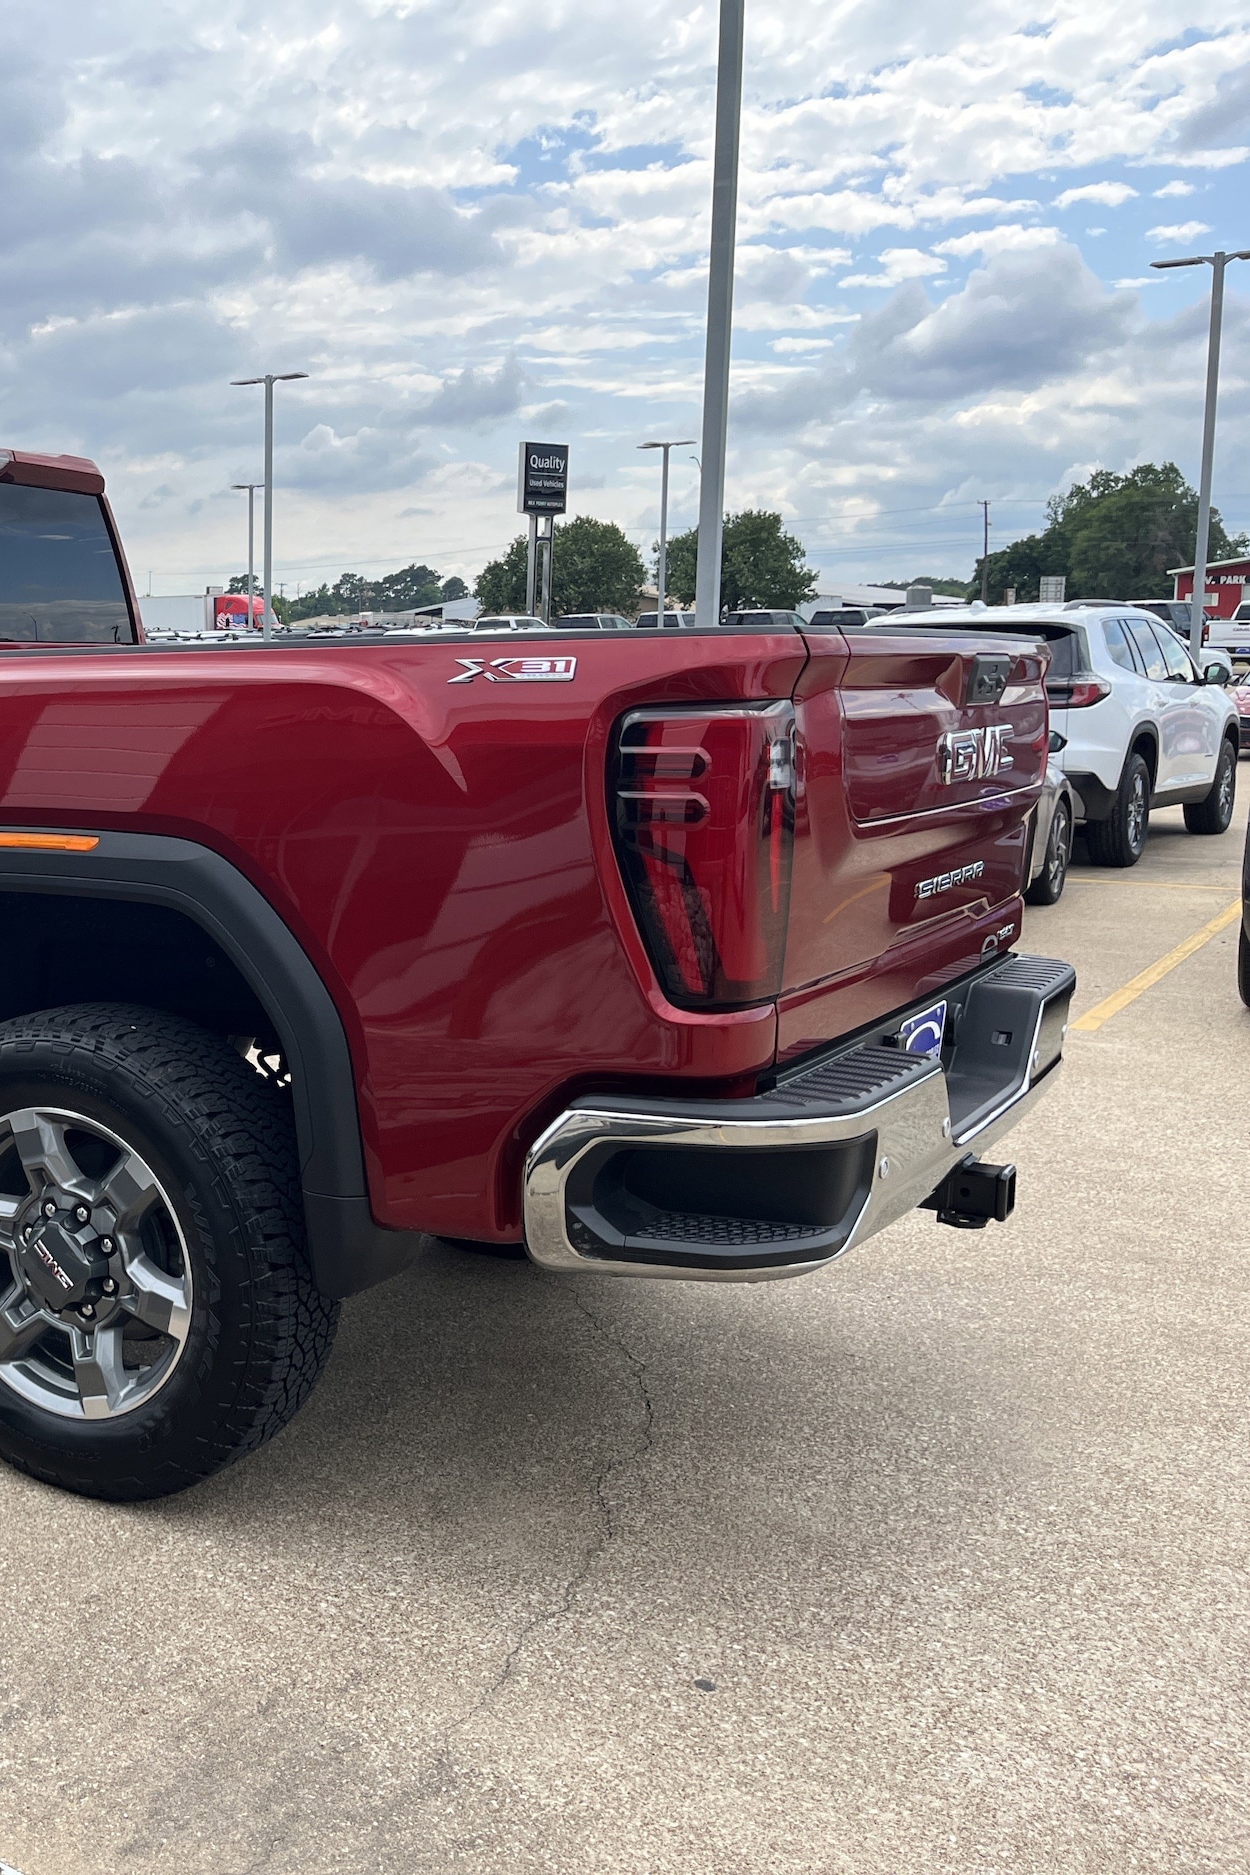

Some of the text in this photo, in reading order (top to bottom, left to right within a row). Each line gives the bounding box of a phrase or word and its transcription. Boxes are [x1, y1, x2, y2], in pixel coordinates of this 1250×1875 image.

[530, 454, 565, 473] Quality
[543, 480, 564, 488] Vehicles
[1220, 575, 1247, 585] PARK
[936, 724, 1015, 786] GMC
[915, 860, 985, 899] SIERRA
[33, 1239, 75, 1292] GMC
